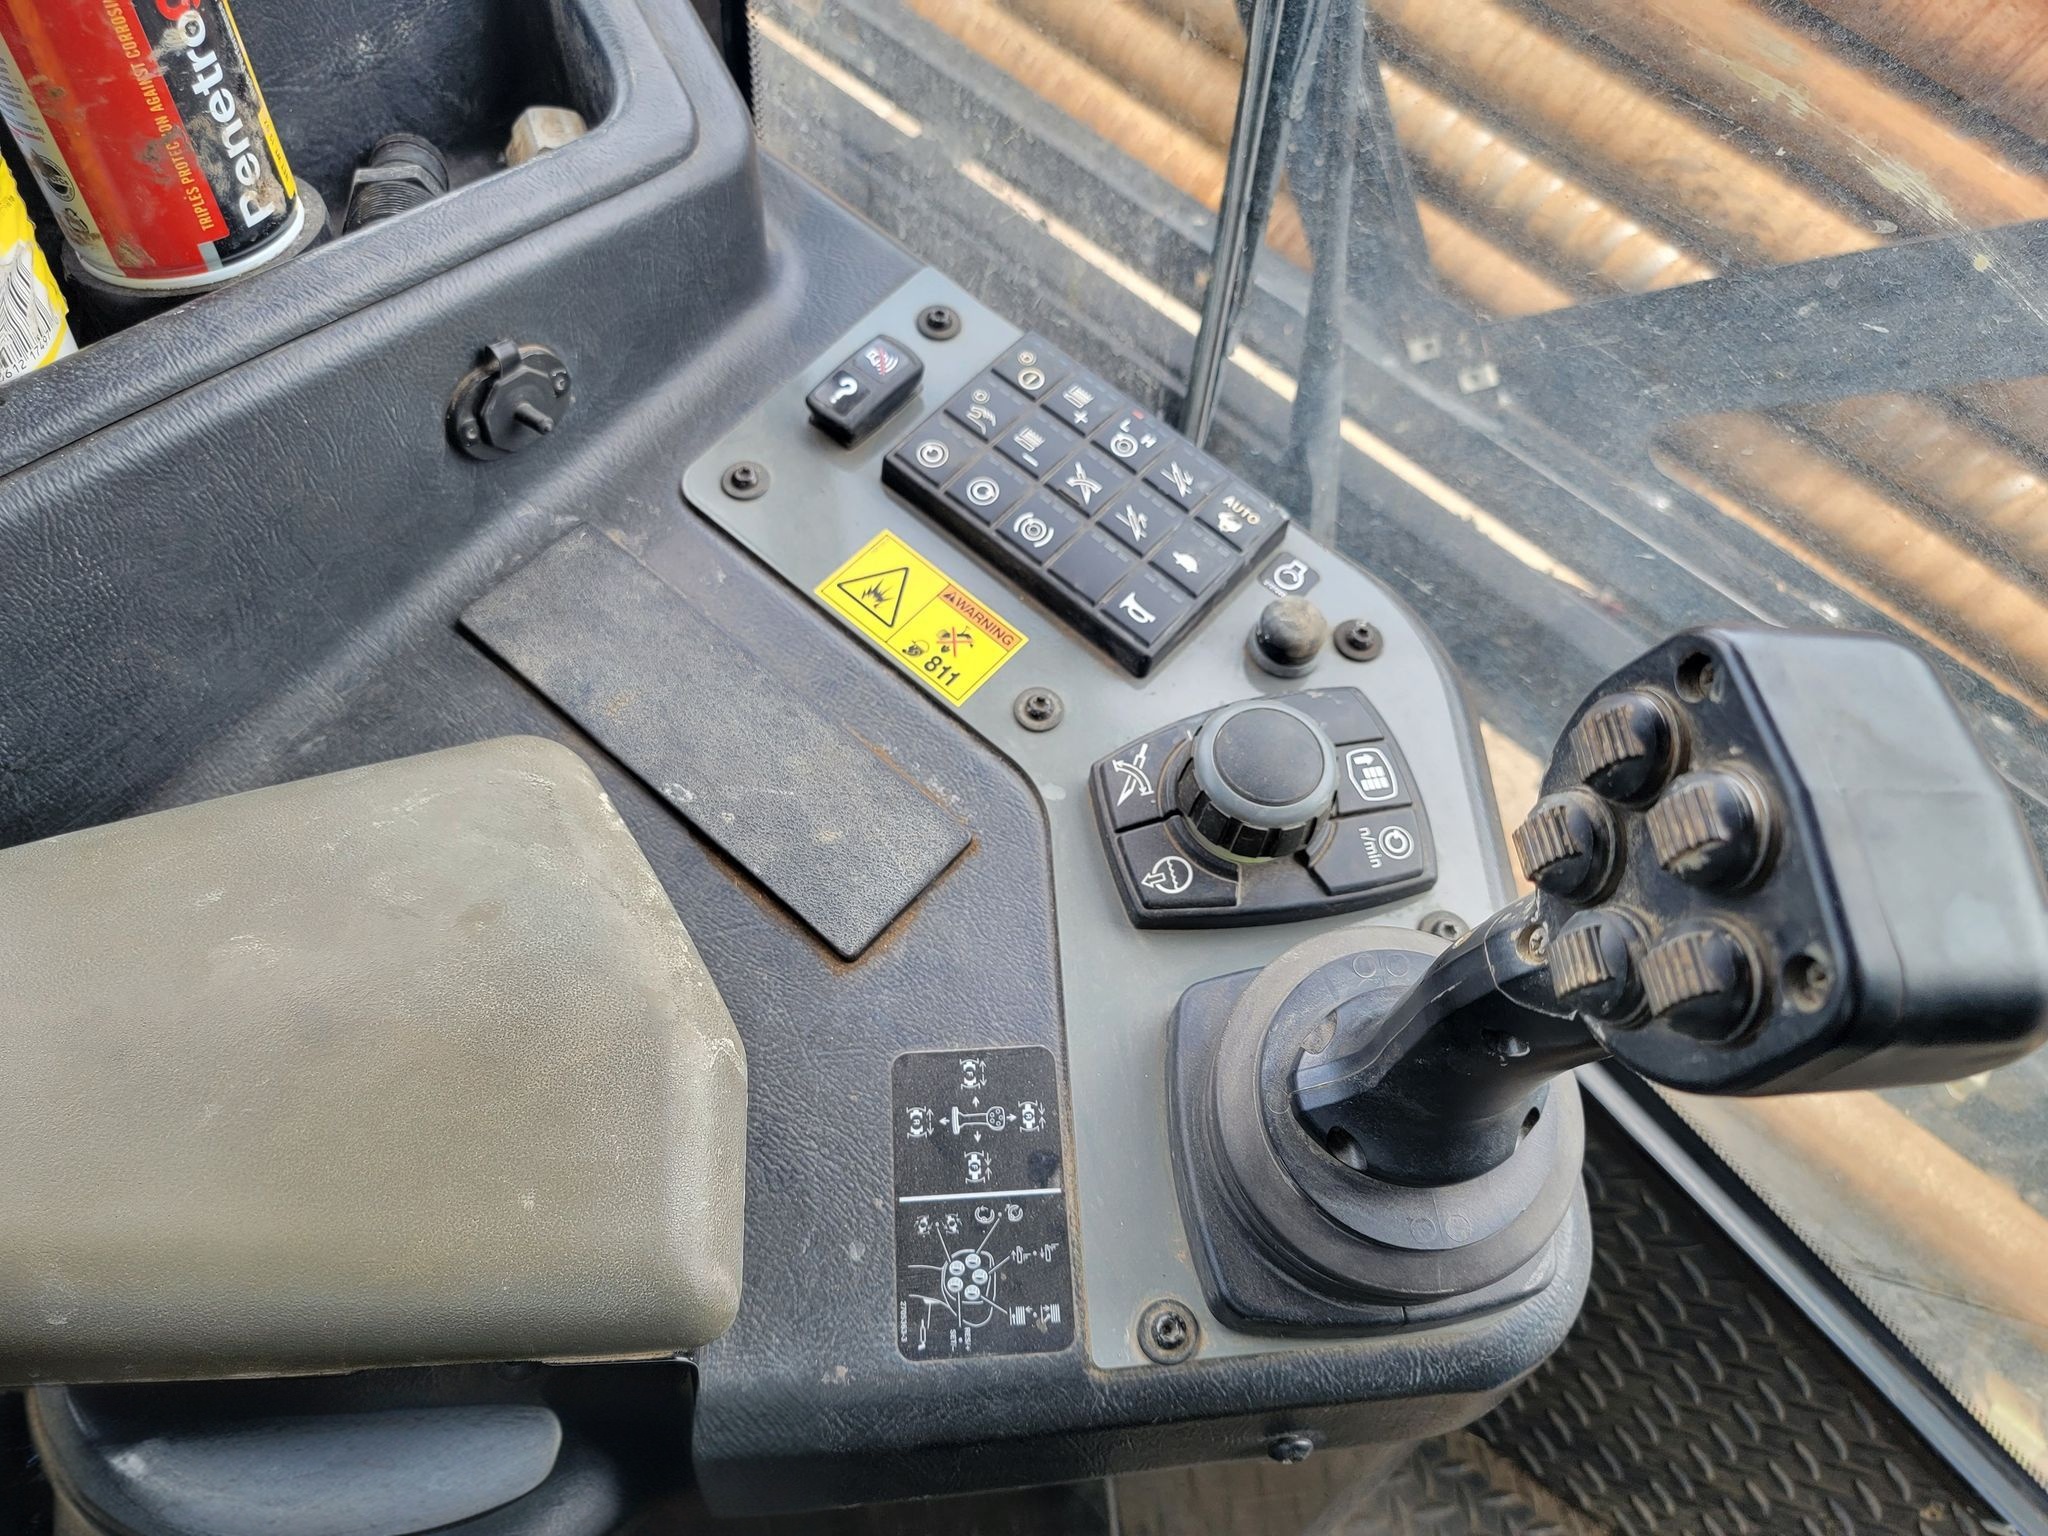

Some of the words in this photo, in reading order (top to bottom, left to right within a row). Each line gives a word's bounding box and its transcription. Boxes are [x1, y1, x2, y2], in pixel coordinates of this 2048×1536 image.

[130, 63, 165, 112] AGAINST
[154, 115, 195, 185] PROTECON
[1222, 495, 1261, 526] AUTO
[955, 597, 1015, 647] WARNING
[923, 655, 961, 687] 811
[1358, 827, 1383, 868] n/min
